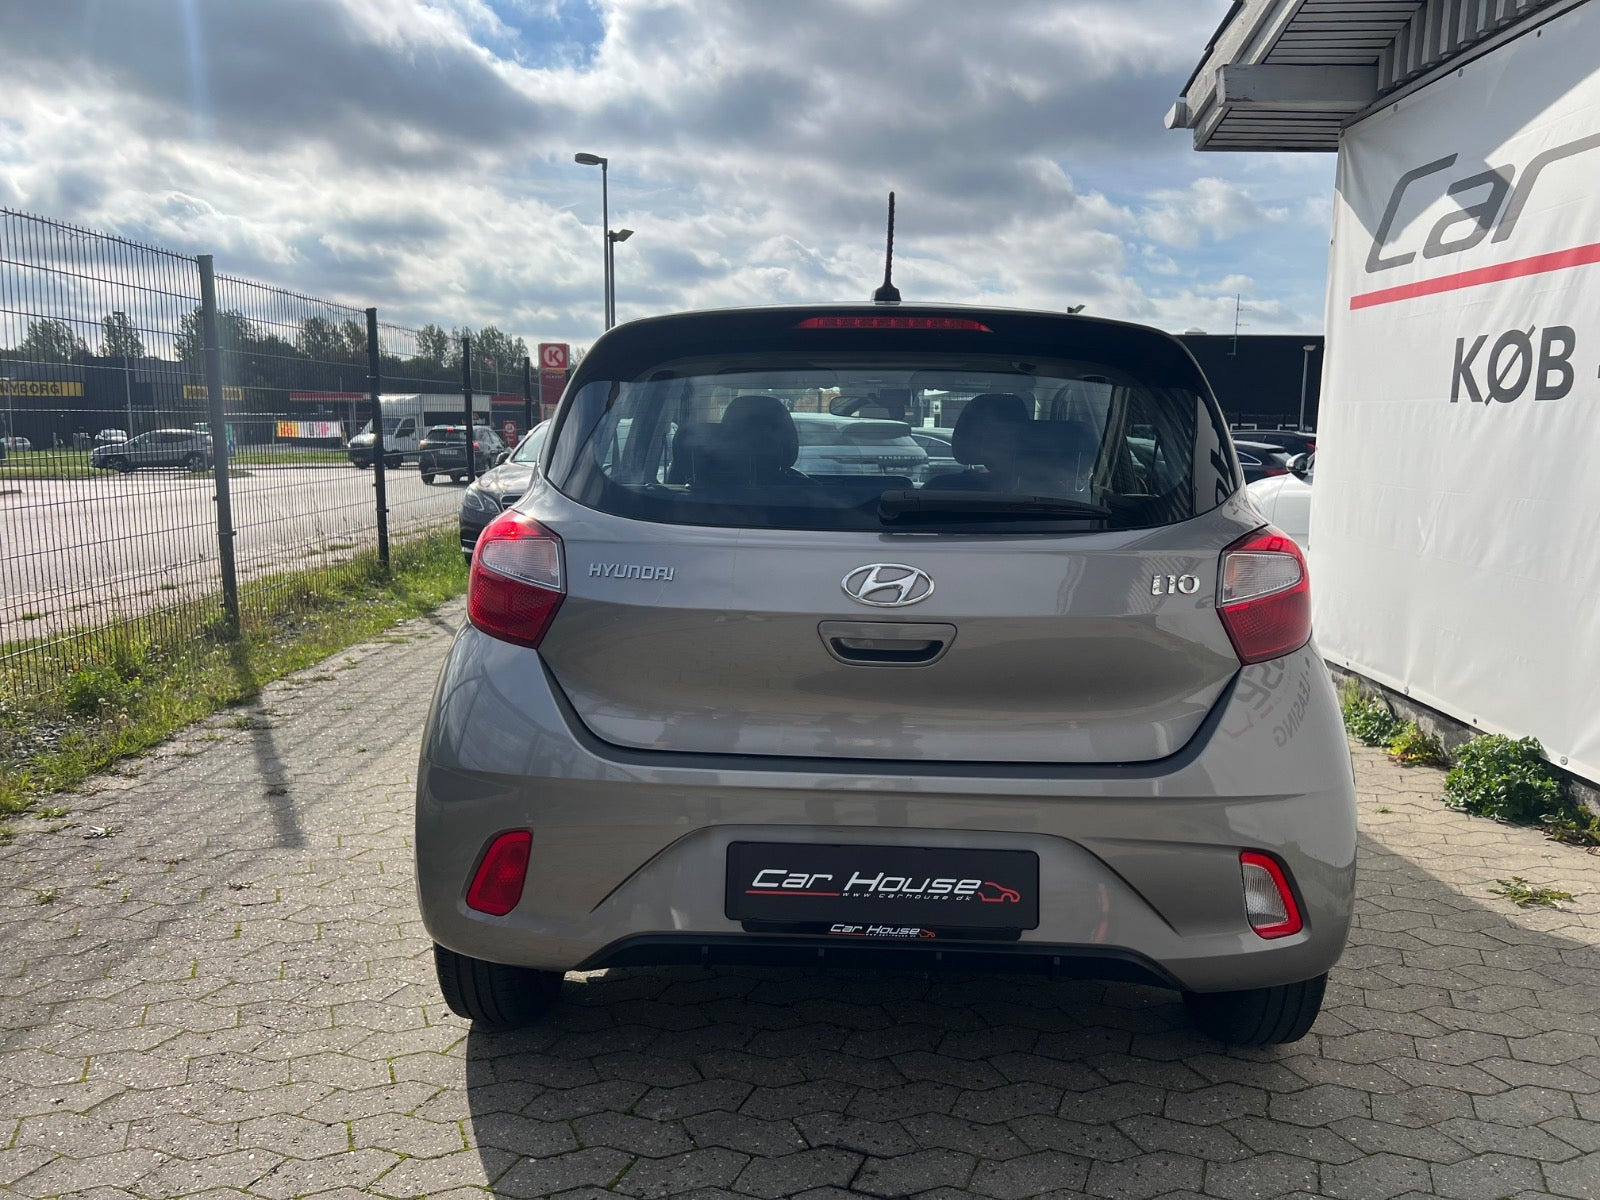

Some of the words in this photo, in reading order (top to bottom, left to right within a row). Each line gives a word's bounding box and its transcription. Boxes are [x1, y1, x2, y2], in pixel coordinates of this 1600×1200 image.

[1365, 132, 1600, 274] Car
[1450, 325, 1576, 406] KØB
[588, 563, 675, 581] HYUNDAI
[752, 869, 833, 889] Car
[843, 871, 982, 895] House
[830, 923, 863, 933] Car
[866, 925, 920, 935] House
